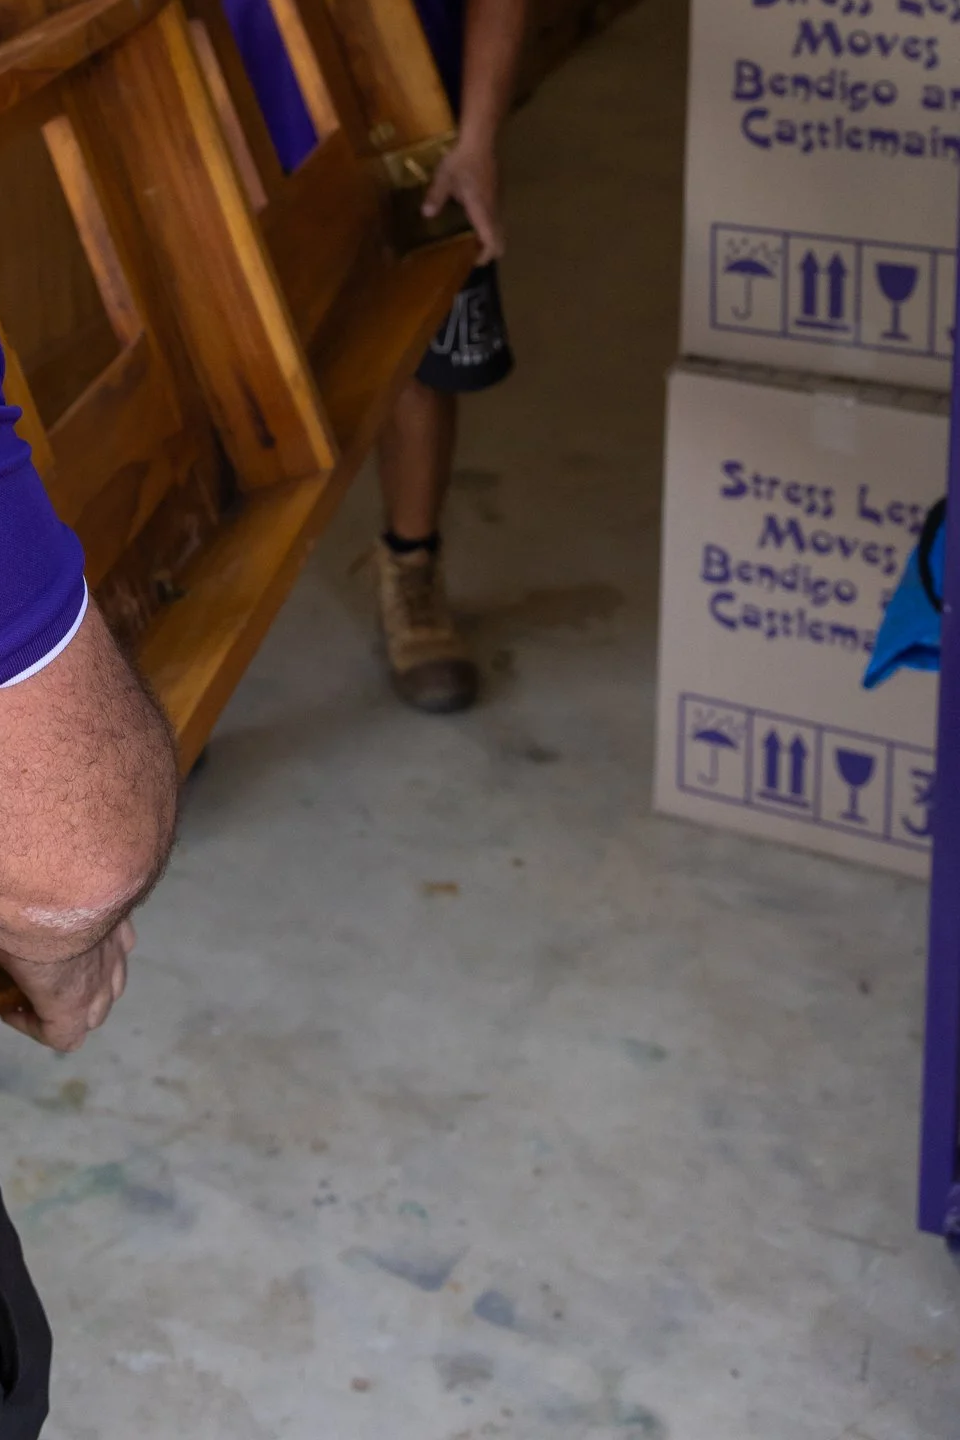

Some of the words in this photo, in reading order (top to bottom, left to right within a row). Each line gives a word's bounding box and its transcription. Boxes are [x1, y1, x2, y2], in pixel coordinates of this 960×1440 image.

[792, 19, 939, 70] Moves
[732, 58, 898, 112] Bendigo
[720, 460, 834, 520] Stress
[758, 513, 897, 576] Moves
[701, 543, 857, 608] Bendigo
